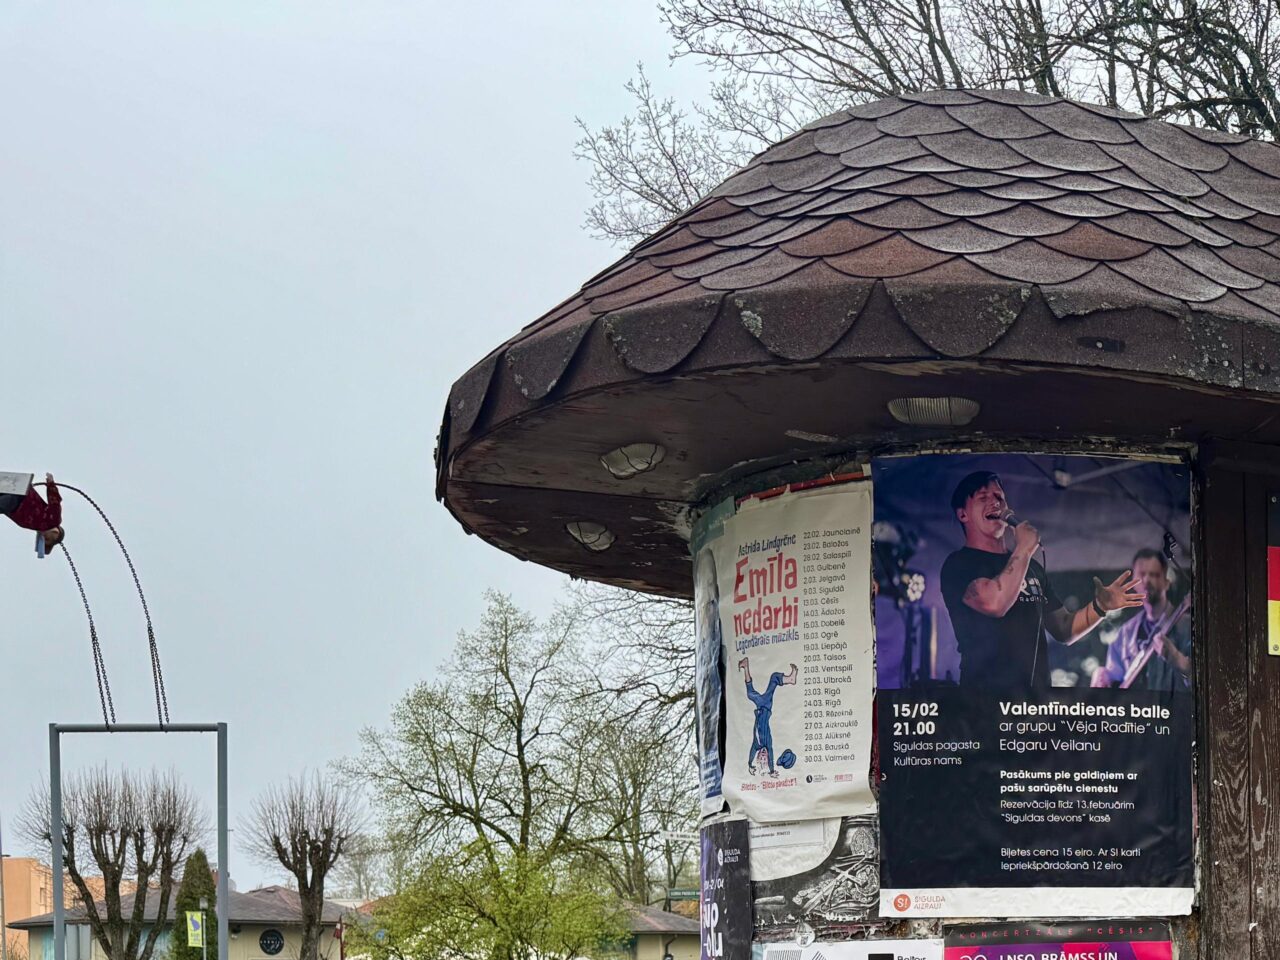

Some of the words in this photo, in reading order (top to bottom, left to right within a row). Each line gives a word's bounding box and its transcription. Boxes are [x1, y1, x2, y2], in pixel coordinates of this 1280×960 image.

[734, 552, 798, 604] Emīla
[734, 596, 798, 637] nedarbi
[893, 703, 938, 718] 15/02
[1000, 702, 1126, 717] Valentīndienas
[1130, 704, 1170, 719] balle
[893, 722, 936, 736] 21.00
[1000, 723, 1012, 732] ar
[1017, 723, 1056, 734] grupu
[1155, 725, 1170, 735] un
[893, 741, 933, 753] Siguldas
[936, 740, 980, 752] pagasta
[1000, 739, 1047, 753] Edgaru
[1051, 739, 1101, 751] Veilanu
[894, 756, 932, 766] Kultūras
[934, 756, 962, 765] nams
[1000, 770, 1052, 779] Pasākums
[1054, 771, 1070, 780] pie
[1074, 771, 1124, 781] galdiņiem
[1000, 783, 1025, 794] pašu
[1028, 783, 1073, 794] sarūpētu
[1076, 785, 1118, 793] cienestu
[1000, 800, 1056, 810] Rezervācija
[1058, 800, 1073, 809] līdz
[1076, 800, 1134, 809] 13.februārim
[1089, 814, 1111, 823] kasē
[1000, 848, 1031, 858] Biļetes
[1062, 848, 1073, 856] 15
[1075, 848, 1095, 856] eiro.
[1098, 848, 1110, 856] Ar
[1120, 848, 1140, 857] karti
[1092, 862, 1102, 870] 12
[1105, 862, 1123, 870] eiro
[960, 928, 1073, 939] KONCERTZĀLE
